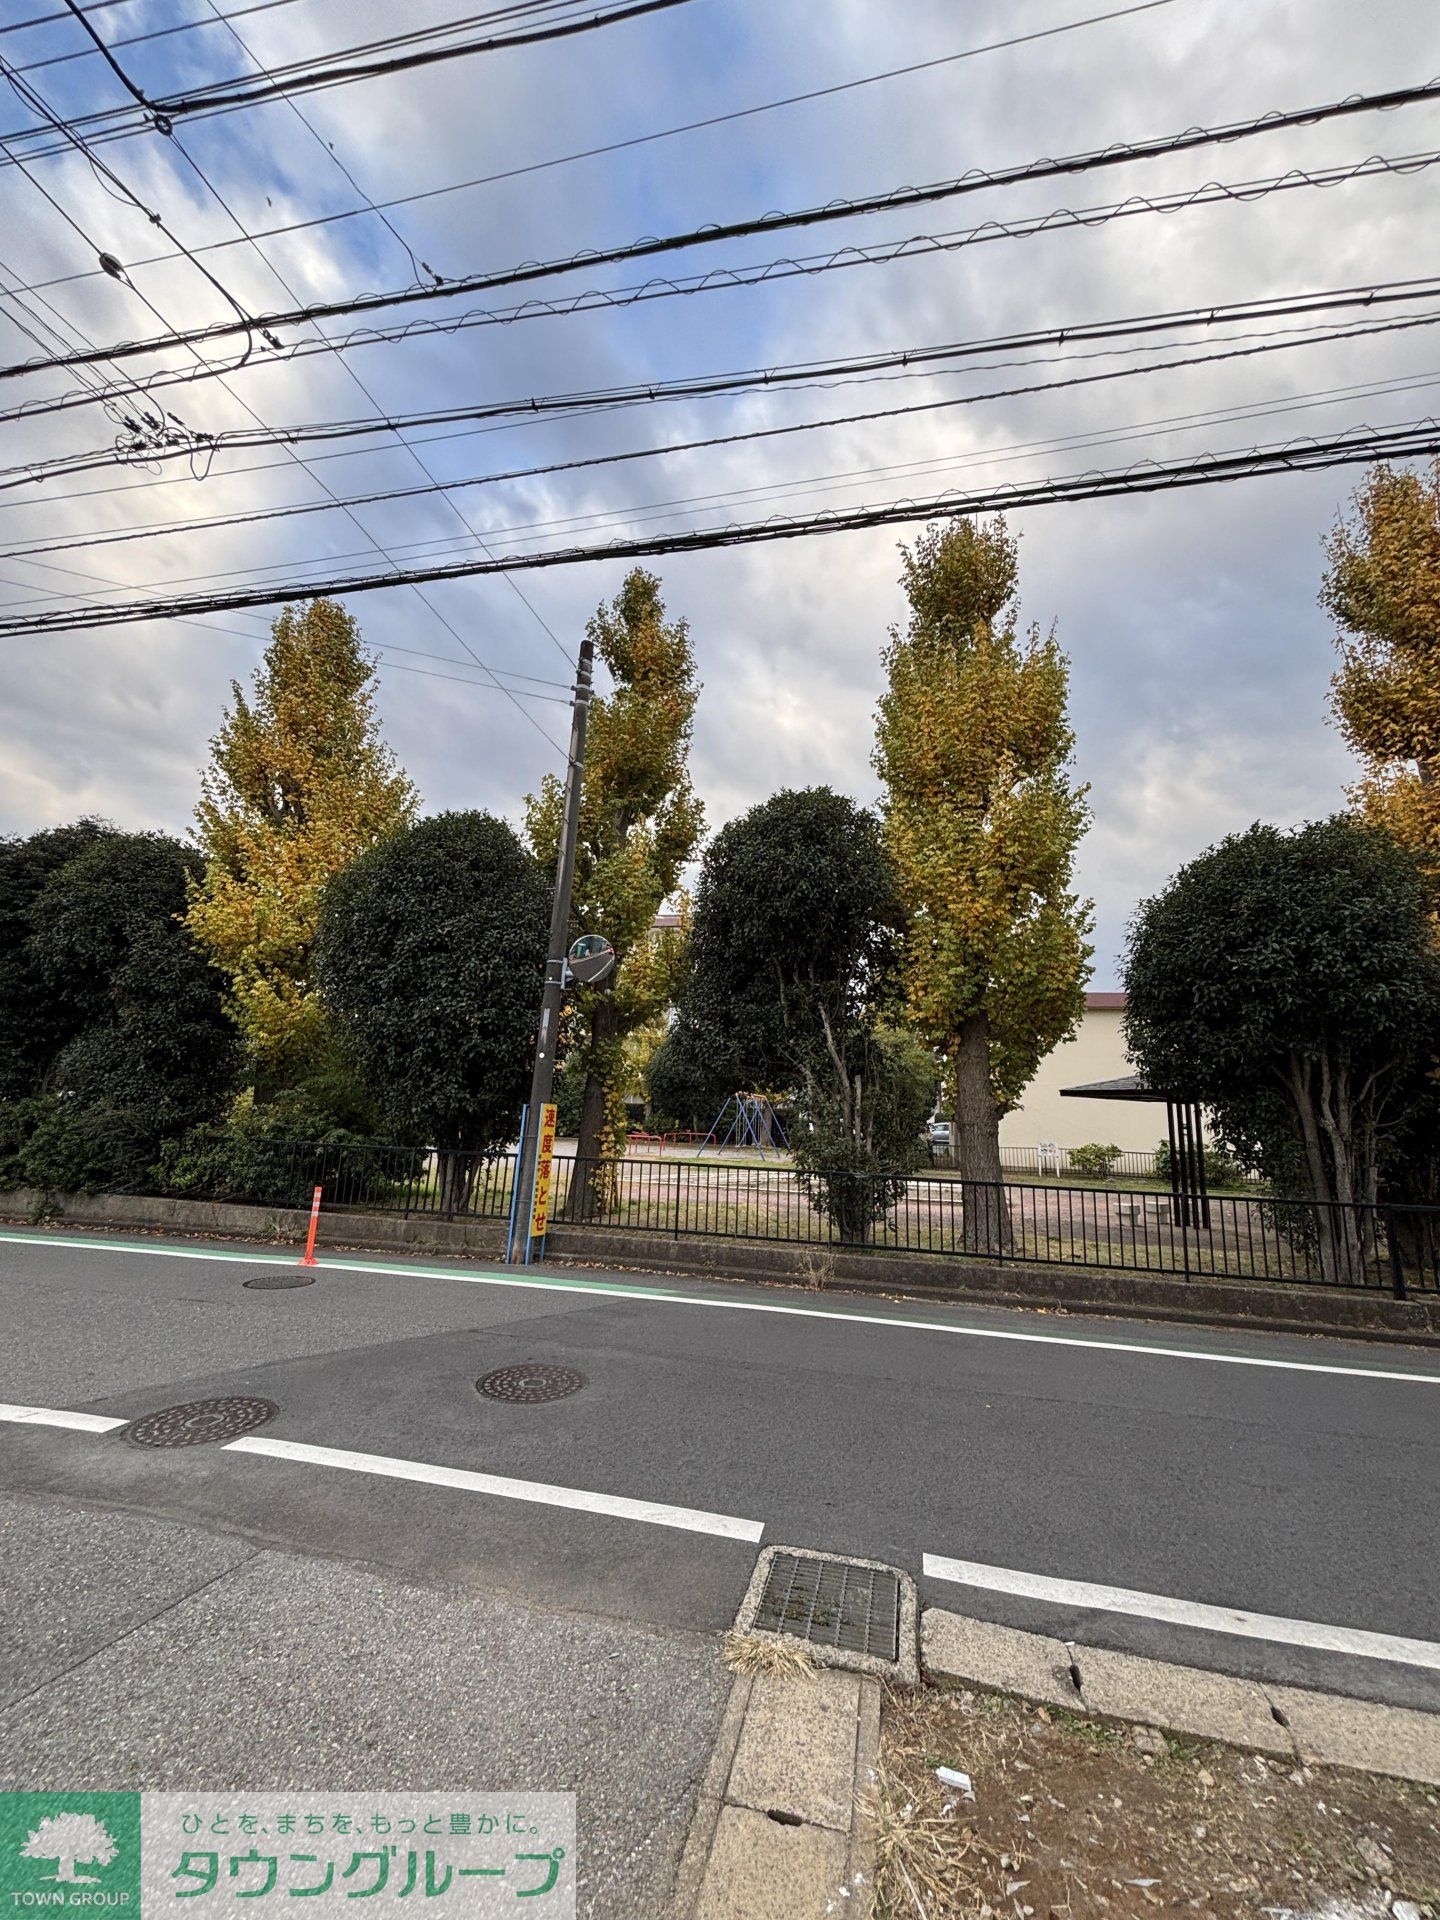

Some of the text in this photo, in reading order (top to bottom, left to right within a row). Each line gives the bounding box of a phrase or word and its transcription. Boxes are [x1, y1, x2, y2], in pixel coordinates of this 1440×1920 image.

[535, 1109, 556, 1231] 速度落とせ
